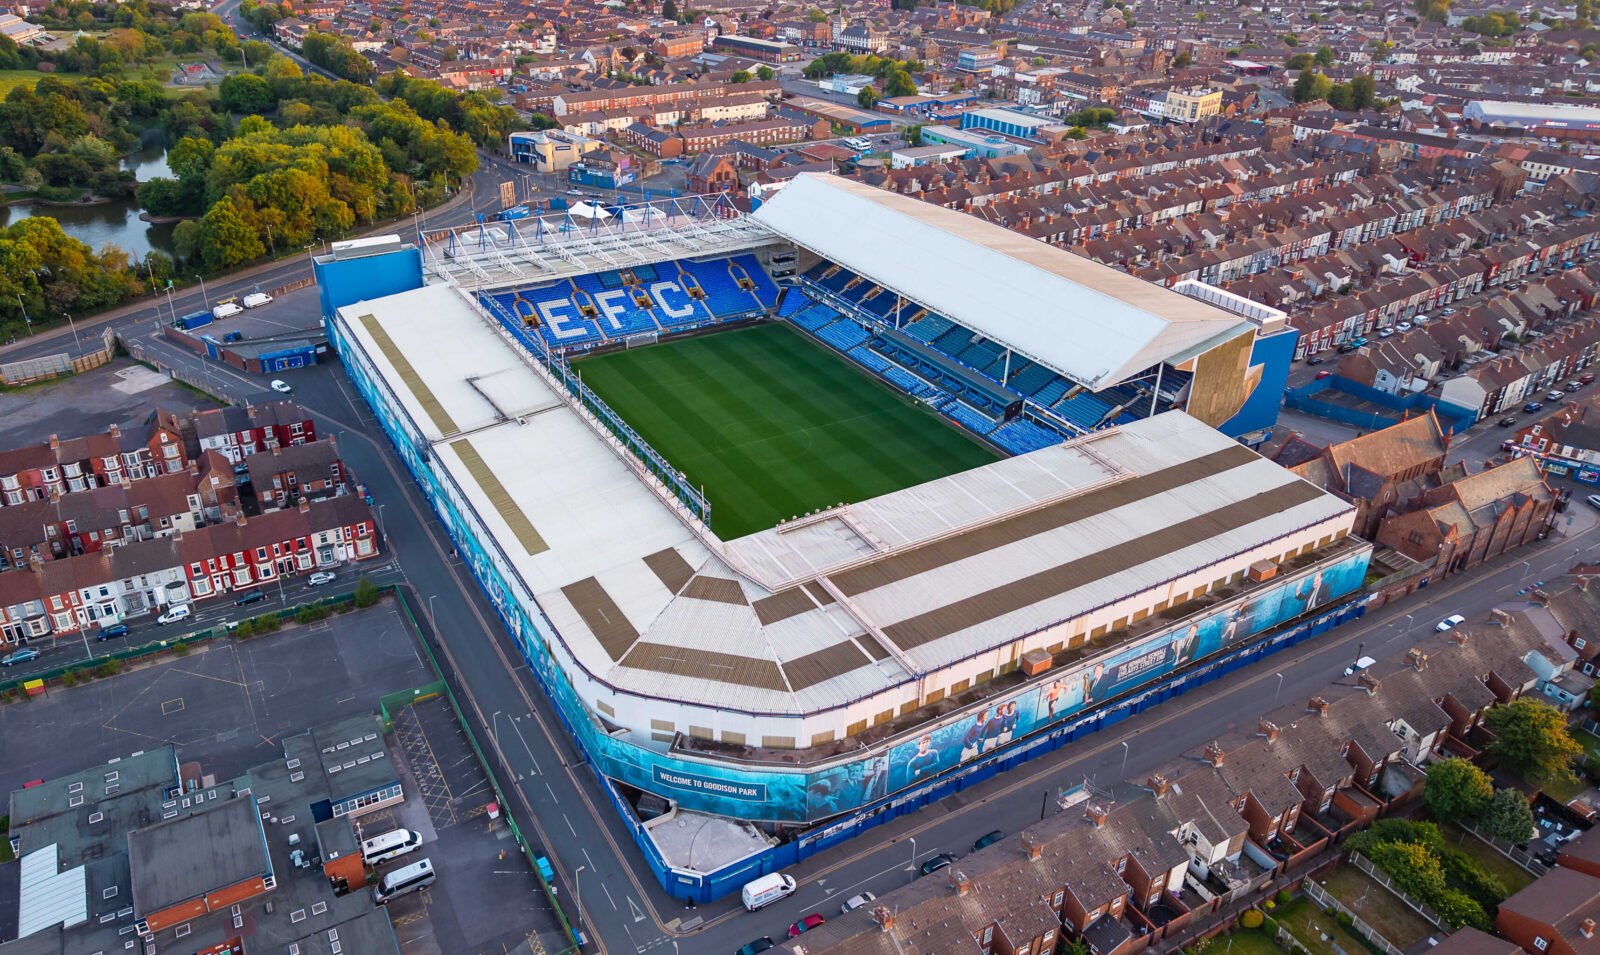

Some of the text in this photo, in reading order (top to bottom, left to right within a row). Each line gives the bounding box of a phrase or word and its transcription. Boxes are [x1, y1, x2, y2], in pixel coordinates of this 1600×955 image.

[537, 281, 694, 340] EFC
[660, 772, 758, 796] WELCOME TO GOODISON PARK
